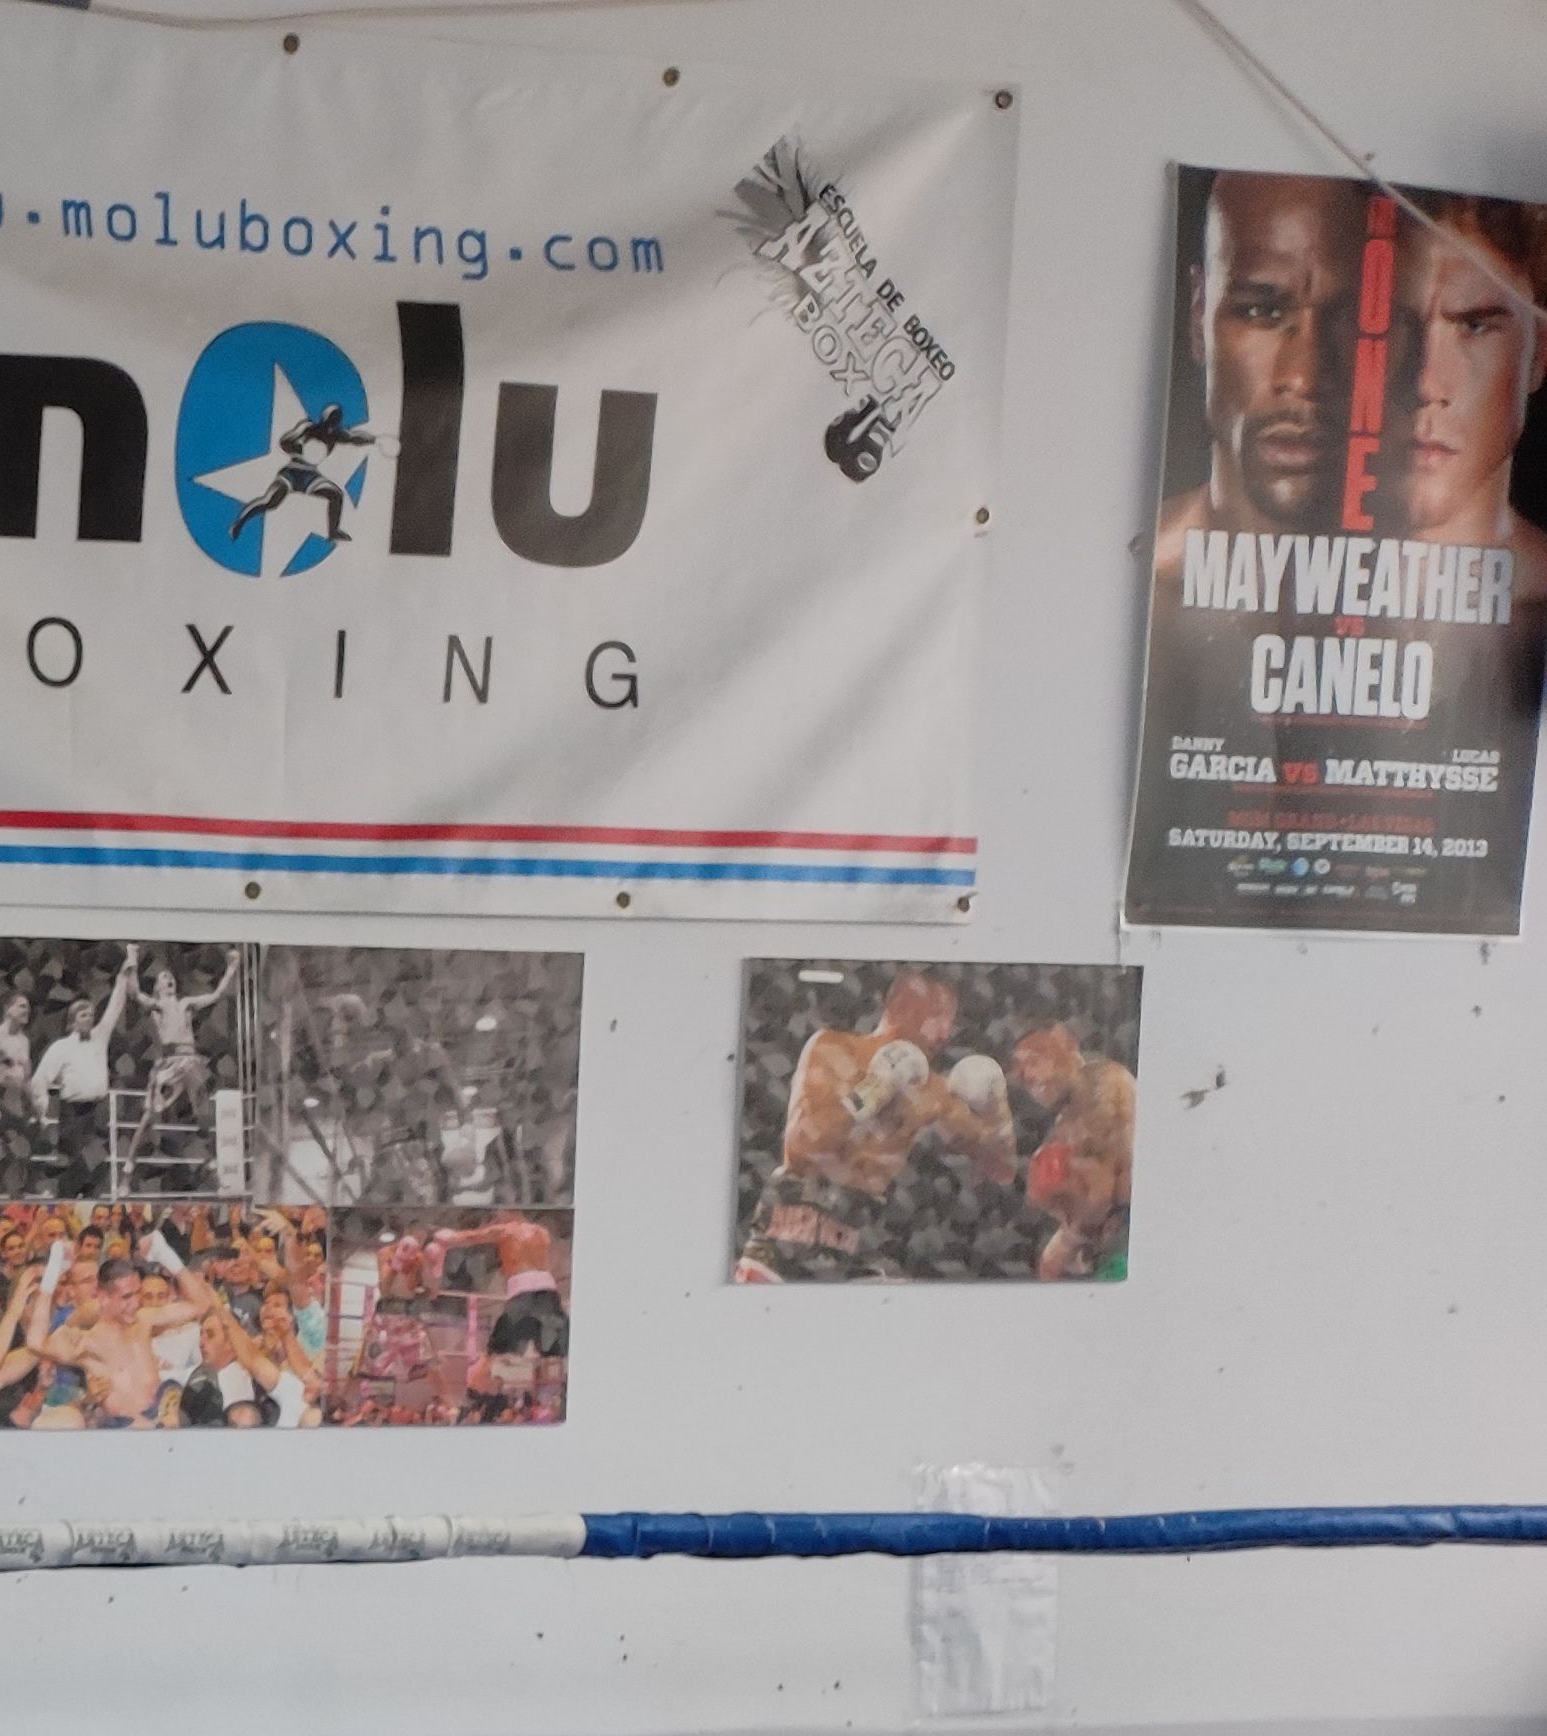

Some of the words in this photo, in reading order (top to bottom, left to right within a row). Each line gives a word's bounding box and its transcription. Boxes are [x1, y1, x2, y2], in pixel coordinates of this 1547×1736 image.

[819, 184, 877, 278] ESCUELA
[876, 278, 905, 312] DE
[903, 314, 955, 381] BOXEO
[1182, 528, 1512, 625] MAYWEATHER
[1251, 633, 1434, 720] CANELO
[1170, 752, 1277, 783] GARCIA
[1324, 758, 1499, 792] MATTHYSSE
[1168, 827, 1282, 855] SATURDAY,
[1286, 832, 1409, 855] SEPTEMBER
